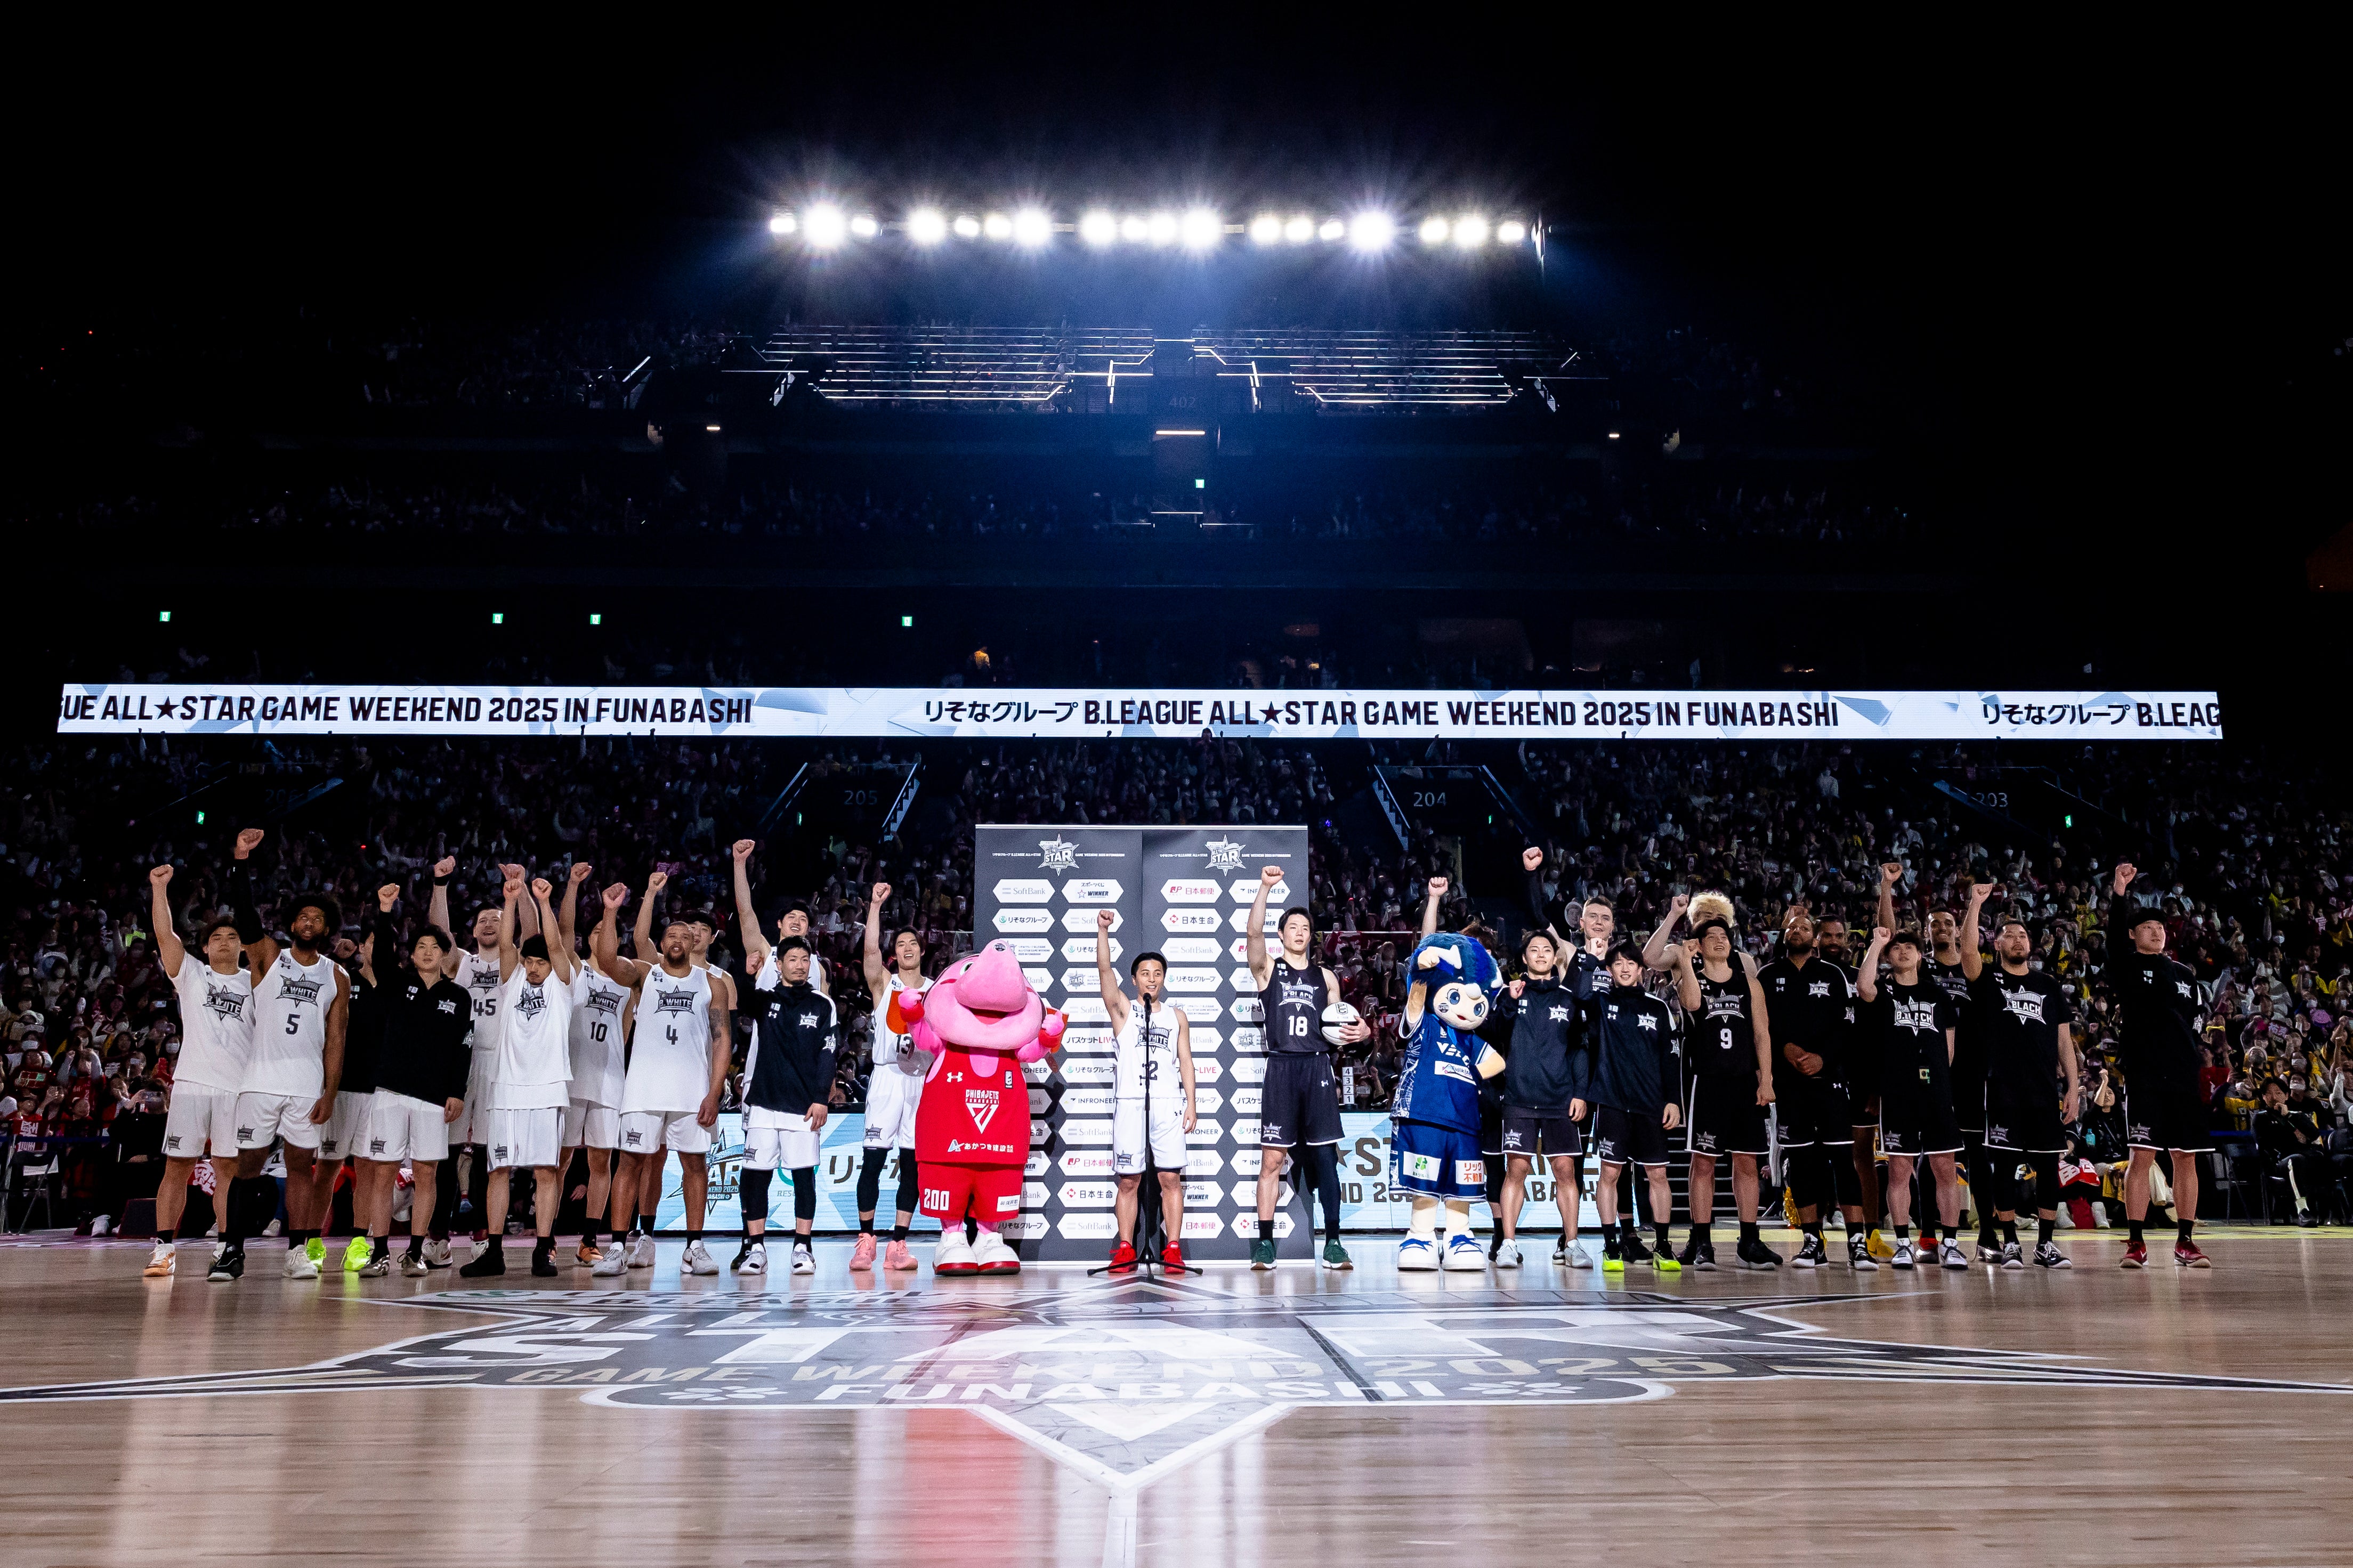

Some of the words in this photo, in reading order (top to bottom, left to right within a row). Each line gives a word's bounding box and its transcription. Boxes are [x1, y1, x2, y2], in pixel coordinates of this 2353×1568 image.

[60, 695, 95, 720] UE
[261, 696, 340, 721] GAME
[351, 697, 482, 721] WEEKEND
[489, 697, 559, 722] 2025
[564, 698, 588, 722] IN
[596, 698, 752, 723] FUNABASHI
[925, 701, 1079, 722] りそなグループ
[1084, 700, 1203, 725] B.LEAGUE
[1364, 701, 1438, 725] GAME
[1446, 701, 1576, 726] WEEKEND
[1583, 702, 1651, 726] 2025
[1657, 702, 1680, 726] IN
[1688, 702, 1838, 726] FUNABASHI
[1983, 703, 2131, 725] りそなグループ
[844, 790, 878, 806] 205
[1413, 792, 1446, 807] 204
[1976, 792, 2008, 807] 203
[1045, 850, 1073, 863] STAR
[1212, 850, 1240, 863] STAR
[1185, 887, 1215, 896] 日本郵便
[281, 985, 317, 1000] B.WHITE
[473, 998, 497, 1017] 45
[659, 997, 692, 1008] B.WHITE
[2011, 1000, 2041, 1014] BLACK
[285, 1013, 301, 1035] 5
[590, 1021, 608, 1043] 10
[1288, 1014, 1308, 1037] 18
[665, 1024, 678, 1045] 4
[1720, 1028, 1733, 1049] 9
[924, 1188, 950, 1211] 200
[1080, 1190, 1113, 1199] 日本生命
[506, 1367, 769, 1383] GAME
[791, 1360, 1324, 1381] WEEKEND
[1363, 1356, 1737, 1377] 2025
[814, 1380, 1445, 1400] FUNABASHI
